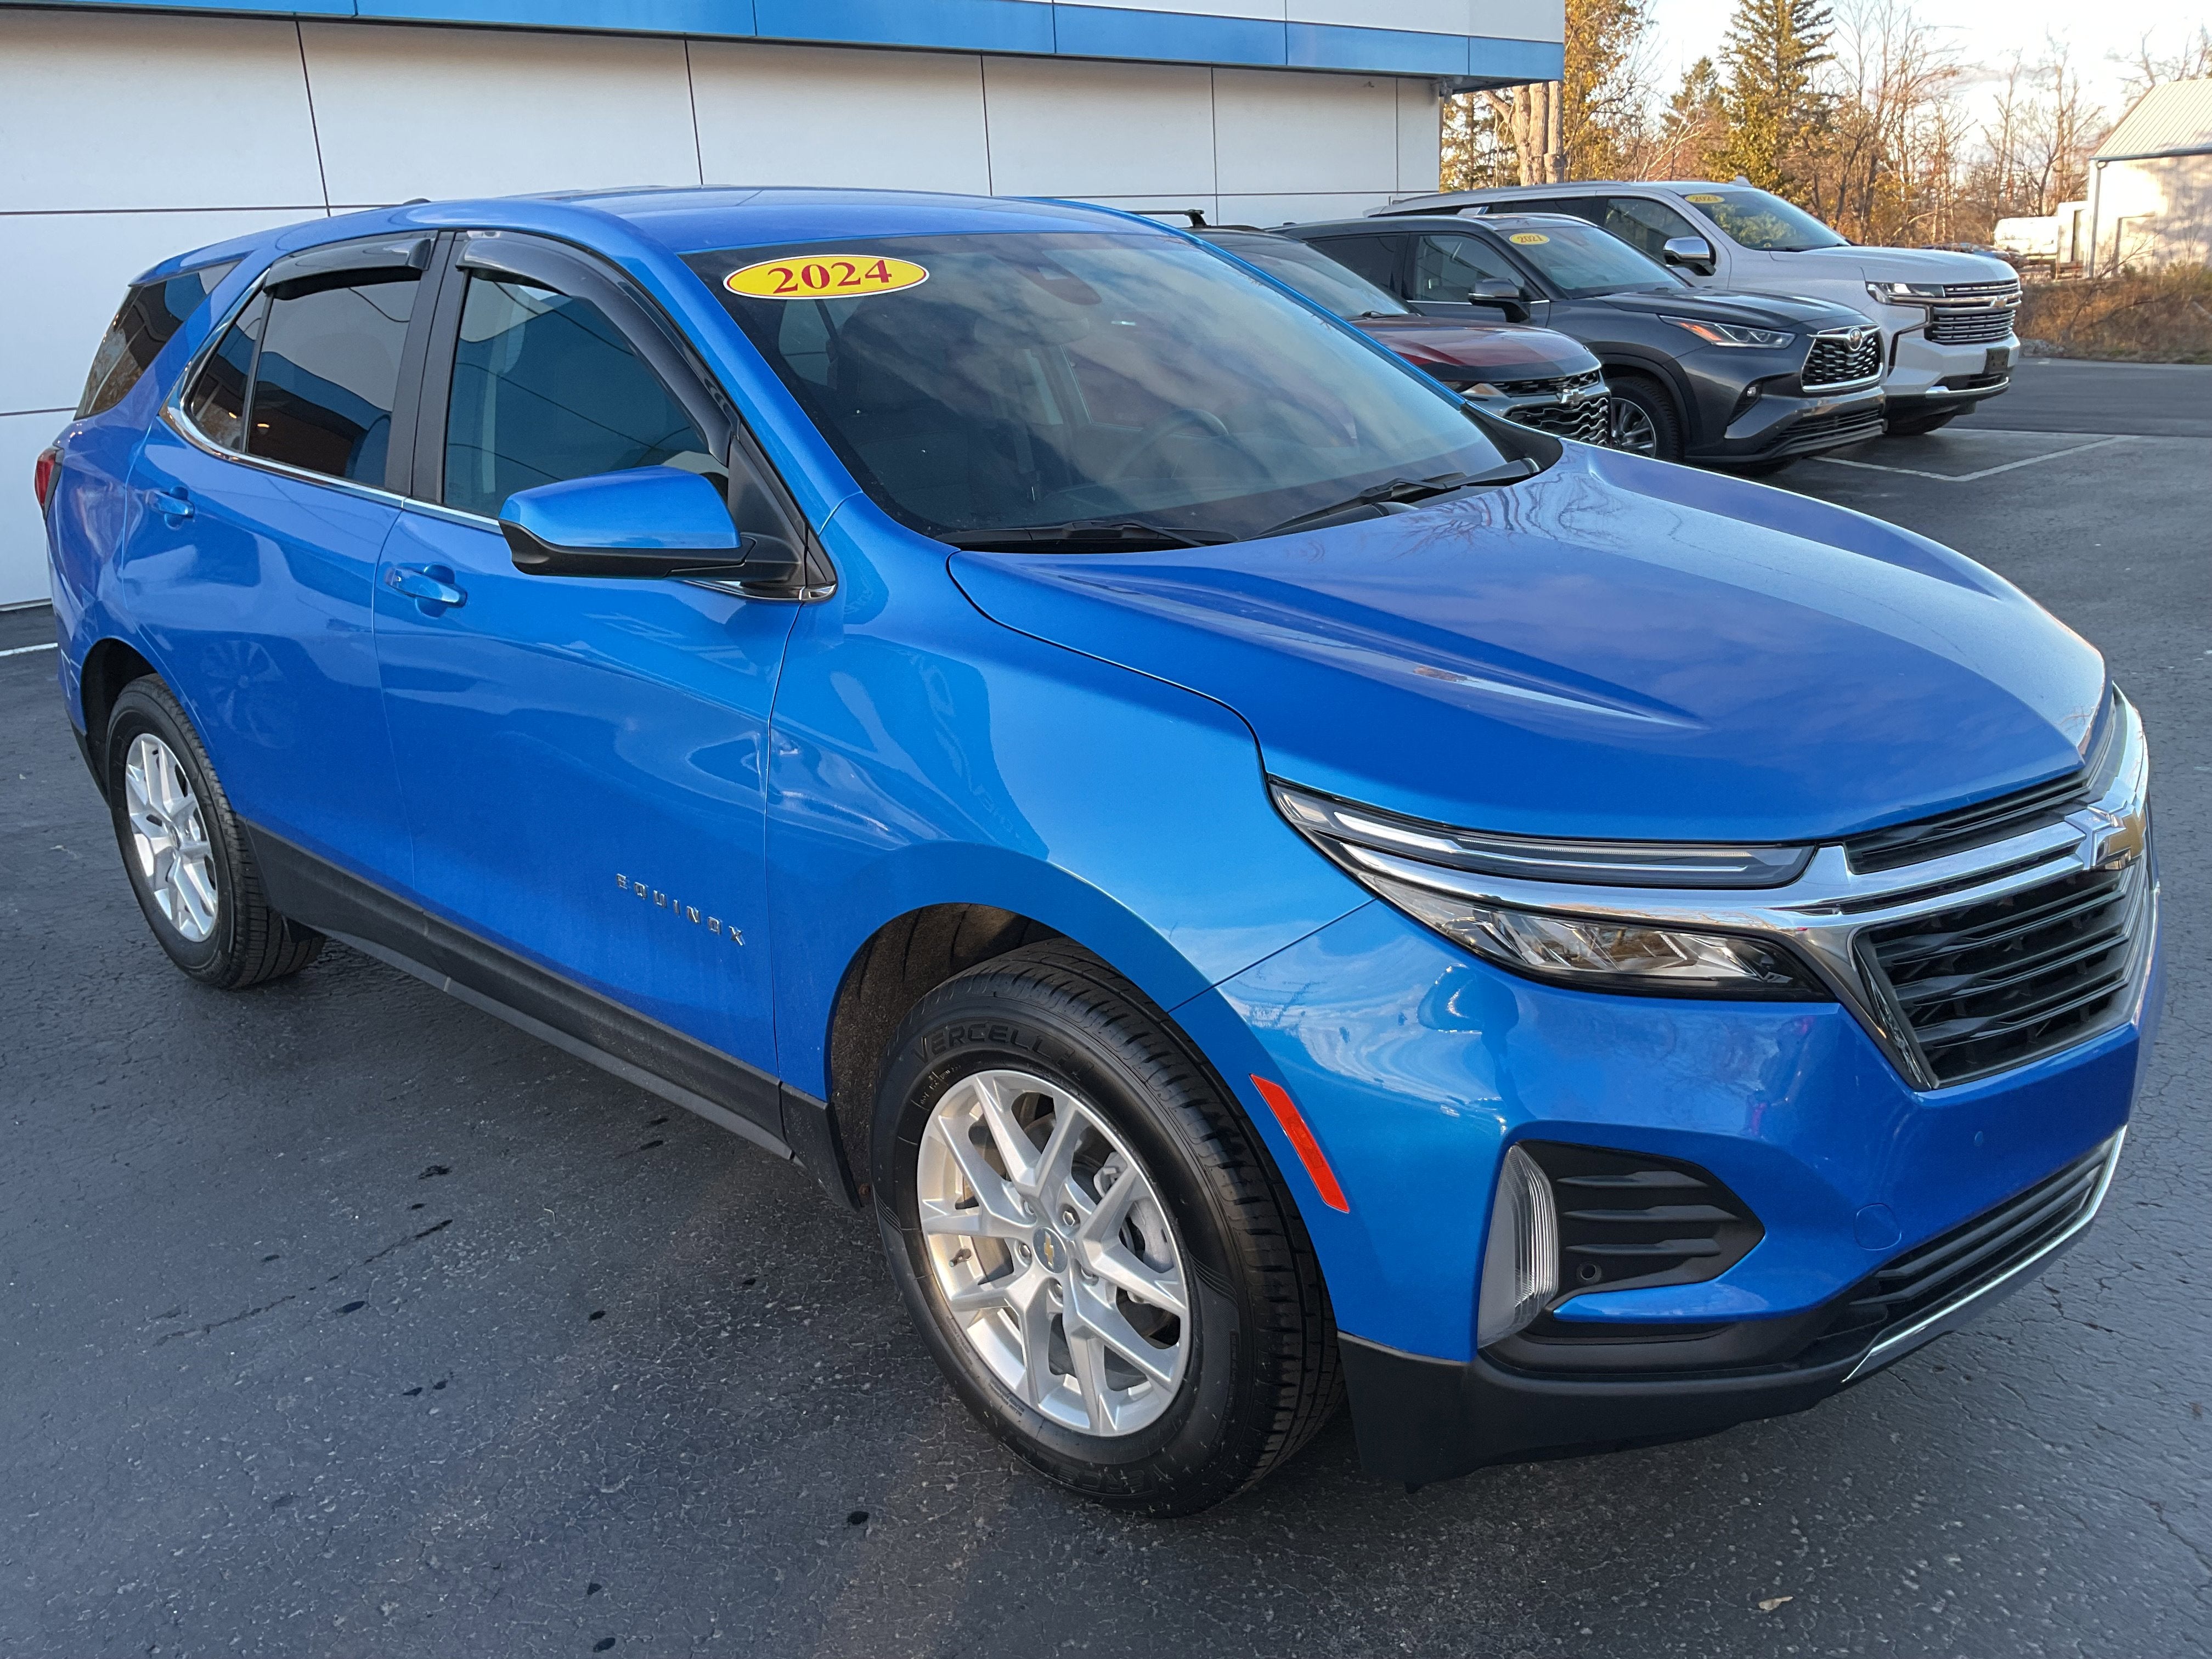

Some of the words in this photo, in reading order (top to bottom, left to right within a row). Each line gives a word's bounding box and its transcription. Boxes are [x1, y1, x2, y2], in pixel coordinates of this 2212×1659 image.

[1517, 235, 1543, 244] 2021
[768, 259, 892, 294] 2024
[616, 873, 746, 946] EQUINOX
